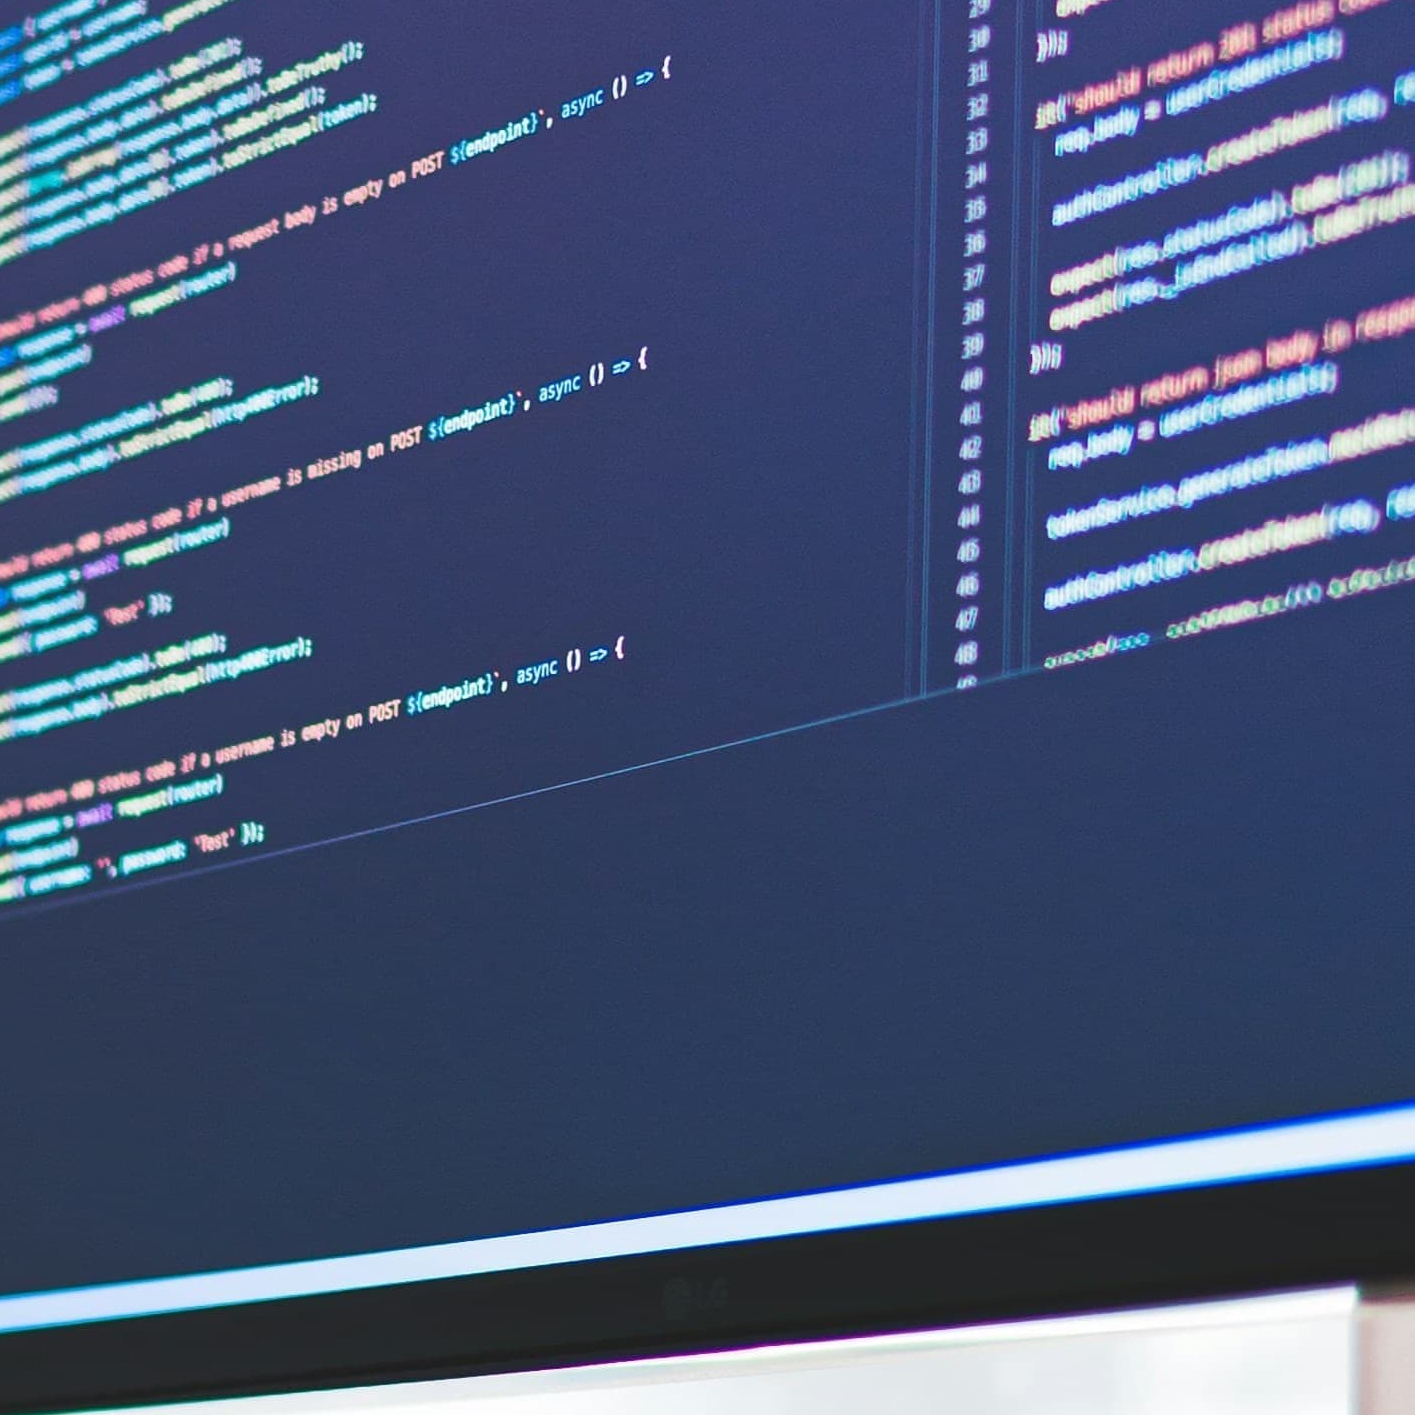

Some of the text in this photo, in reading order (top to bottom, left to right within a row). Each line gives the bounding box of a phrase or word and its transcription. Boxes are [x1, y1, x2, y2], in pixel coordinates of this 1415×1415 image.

[967, 24, 987, 50] 30
[965, 127, 985, 152] 33
[1145, 45, 1211, 85] return
[157, 253, 188, 279] code
[192, 243, 209, 265] if
[227, 215, 280, 251] request
[285, 203, 317, 228] body
[322, 195, 339, 214] is
[344, 177, 384, 205] empty
[390, 169, 406, 187] on
[413, 150, 445, 178] POST
[563, 90, 603, 117] async
[611, 76, 628, 101] ()
[636, 70, 653, 86] =>
[962, 229, 982, 254] 36
[960, 332, 980, 356] 39
[1138, 369, 1204, 405] return
[1266, 332, 1314, 366] body
[150, 506, 181, 530] code
[185, 497, 202, 519] if
[220, 475, 281, 507] username
[286, 467, 302, 486] is
[308, 449, 362, 478] missing
[368, 442, 384, 459] on
[390, 425, 422, 451] POST
[539, 377, 580, 401] async
[588, 364, 604, 389] ()
[613, 360, 629, 375] =>
[143, 759, 174, 782] code
[178, 752, 195, 773] if
[213, 735, 274, 764] username
[279, 728, 295, 747] is
[301, 716, 340, 741] empty
[346, 713, 362, 729] on
[368, 699, 400, 723] POST
[516, 661, 557, 684] async
[564, 651, 581, 674] ()
[589, 649, 605, 663] =>
